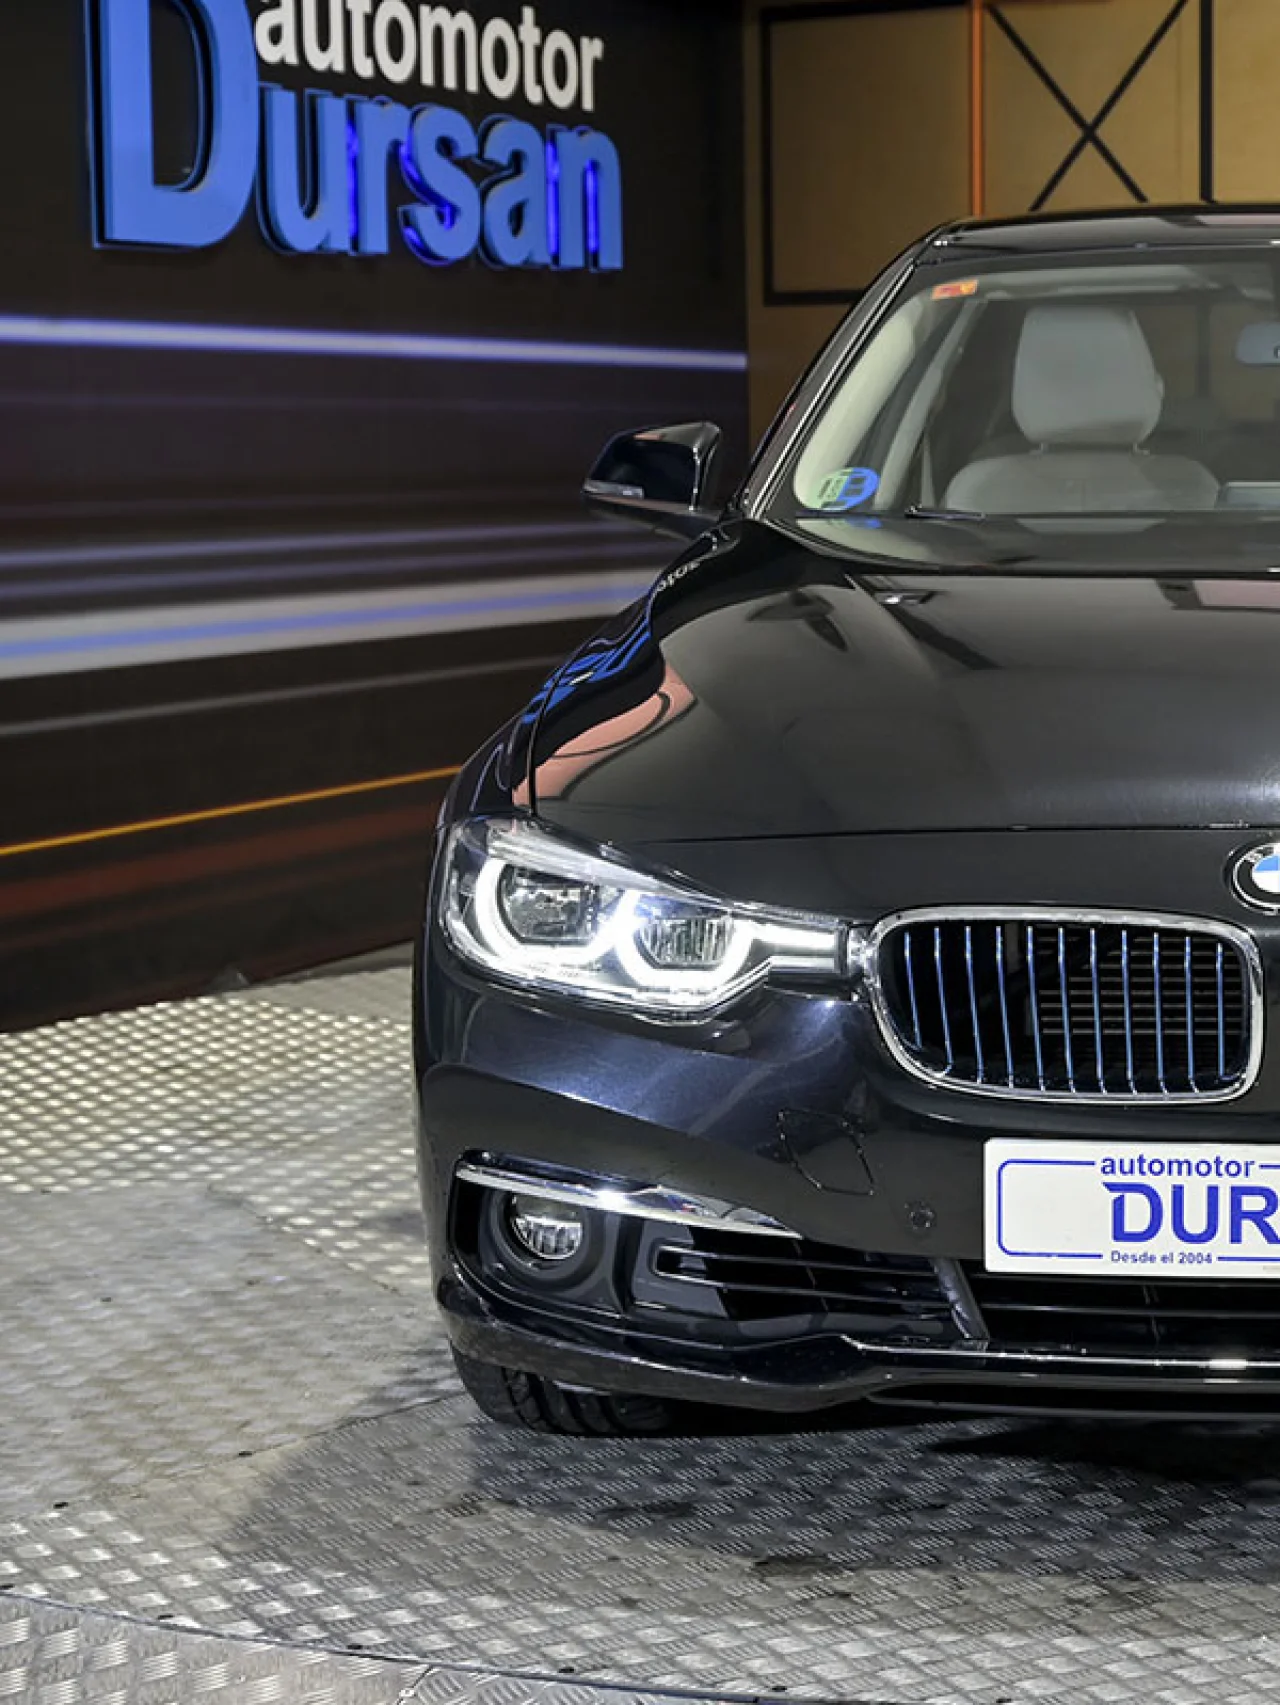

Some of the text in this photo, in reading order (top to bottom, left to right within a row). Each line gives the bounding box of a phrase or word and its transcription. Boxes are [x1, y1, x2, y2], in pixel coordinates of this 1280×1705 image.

[254, 0, 604, 112] automotor
[85, 0, 623, 271] Dursan
[1101, 1155, 1255, 1178] automotor
[1111, 1251, 1213, 1264] Desde el 2004
